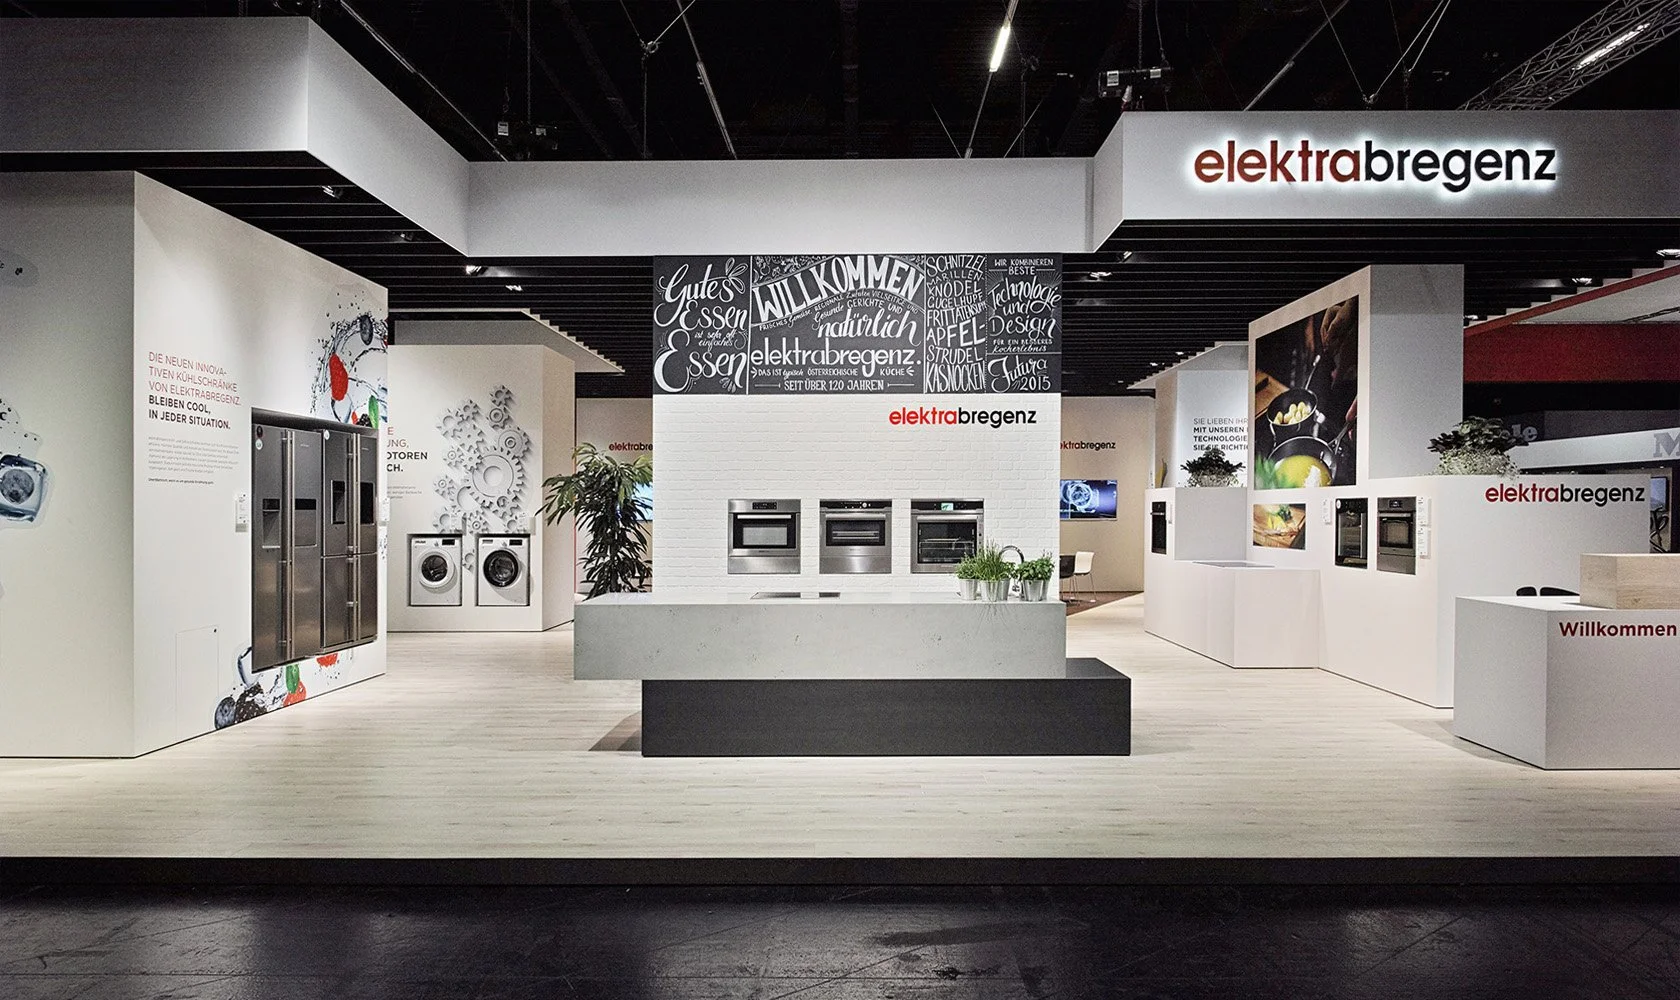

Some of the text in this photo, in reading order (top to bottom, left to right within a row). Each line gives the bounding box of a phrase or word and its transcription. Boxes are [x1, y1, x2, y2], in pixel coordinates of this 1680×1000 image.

[1194, 140, 1557, 193] elektrabregenz
[926, 254, 986, 277] SCHNITZEL
[994, 258, 1054, 267] WIR KOMBINIEREN
[1008, 265, 1036, 275] BESTE
[654, 264, 735, 327] Gutes
[752, 255, 925, 322] WILLKOMMEN
[927, 291, 983, 309] GUGELHUPF
[987, 276, 1062, 314] Technologie
[679, 299, 748, 331] Essen
[847, 297, 885, 309] GERICHTE
[887, 302, 903, 315] UND
[1003, 300, 1032, 316] und
[760, 318, 788, 331] FRISCHES
[817, 308, 922, 347] natürlich
[927, 316, 986, 347] APFEL-
[988, 315, 1054, 339] Design
[148, 351, 227, 376] DIE NEUEN INNOVA-
[654, 328, 747, 393] Essen
[926, 345, 983, 364] STRUDEL
[149, 365, 238, 393] TIVEN KÜHLSCHRÄNKE
[758, 368, 771, 377] DAS
[773, 368, 782, 377] IST
[807, 367, 858, 377] ÖSTERREICHISCHE
[880, 367, 905, 377] KÜCHE
[924, 360, 986, 393] KASNOCKEN
[987, 355, 1048, 393] Futura
[1020, 376, 1051, 391] 2015
[149, 380, 242, 406] VON ELEKTRABREGENZ.
[783, 378, 884, 391] SEIT ÜBER 120 JAHREN
[149, 394, 211, 415] BLEIBEN COOL,
[148, 409, 231, 429] IN JEDER SITUATION.
[889, 406, 1037, 428] elektrabregenz
[1193, 417, 1205, 425] SIE
[1207, 417, 1234, 425] LIEBEN
[1485, 483, 1645, 508] elektrabregenz
[1559, 621, 1677, 637] Willkommen
